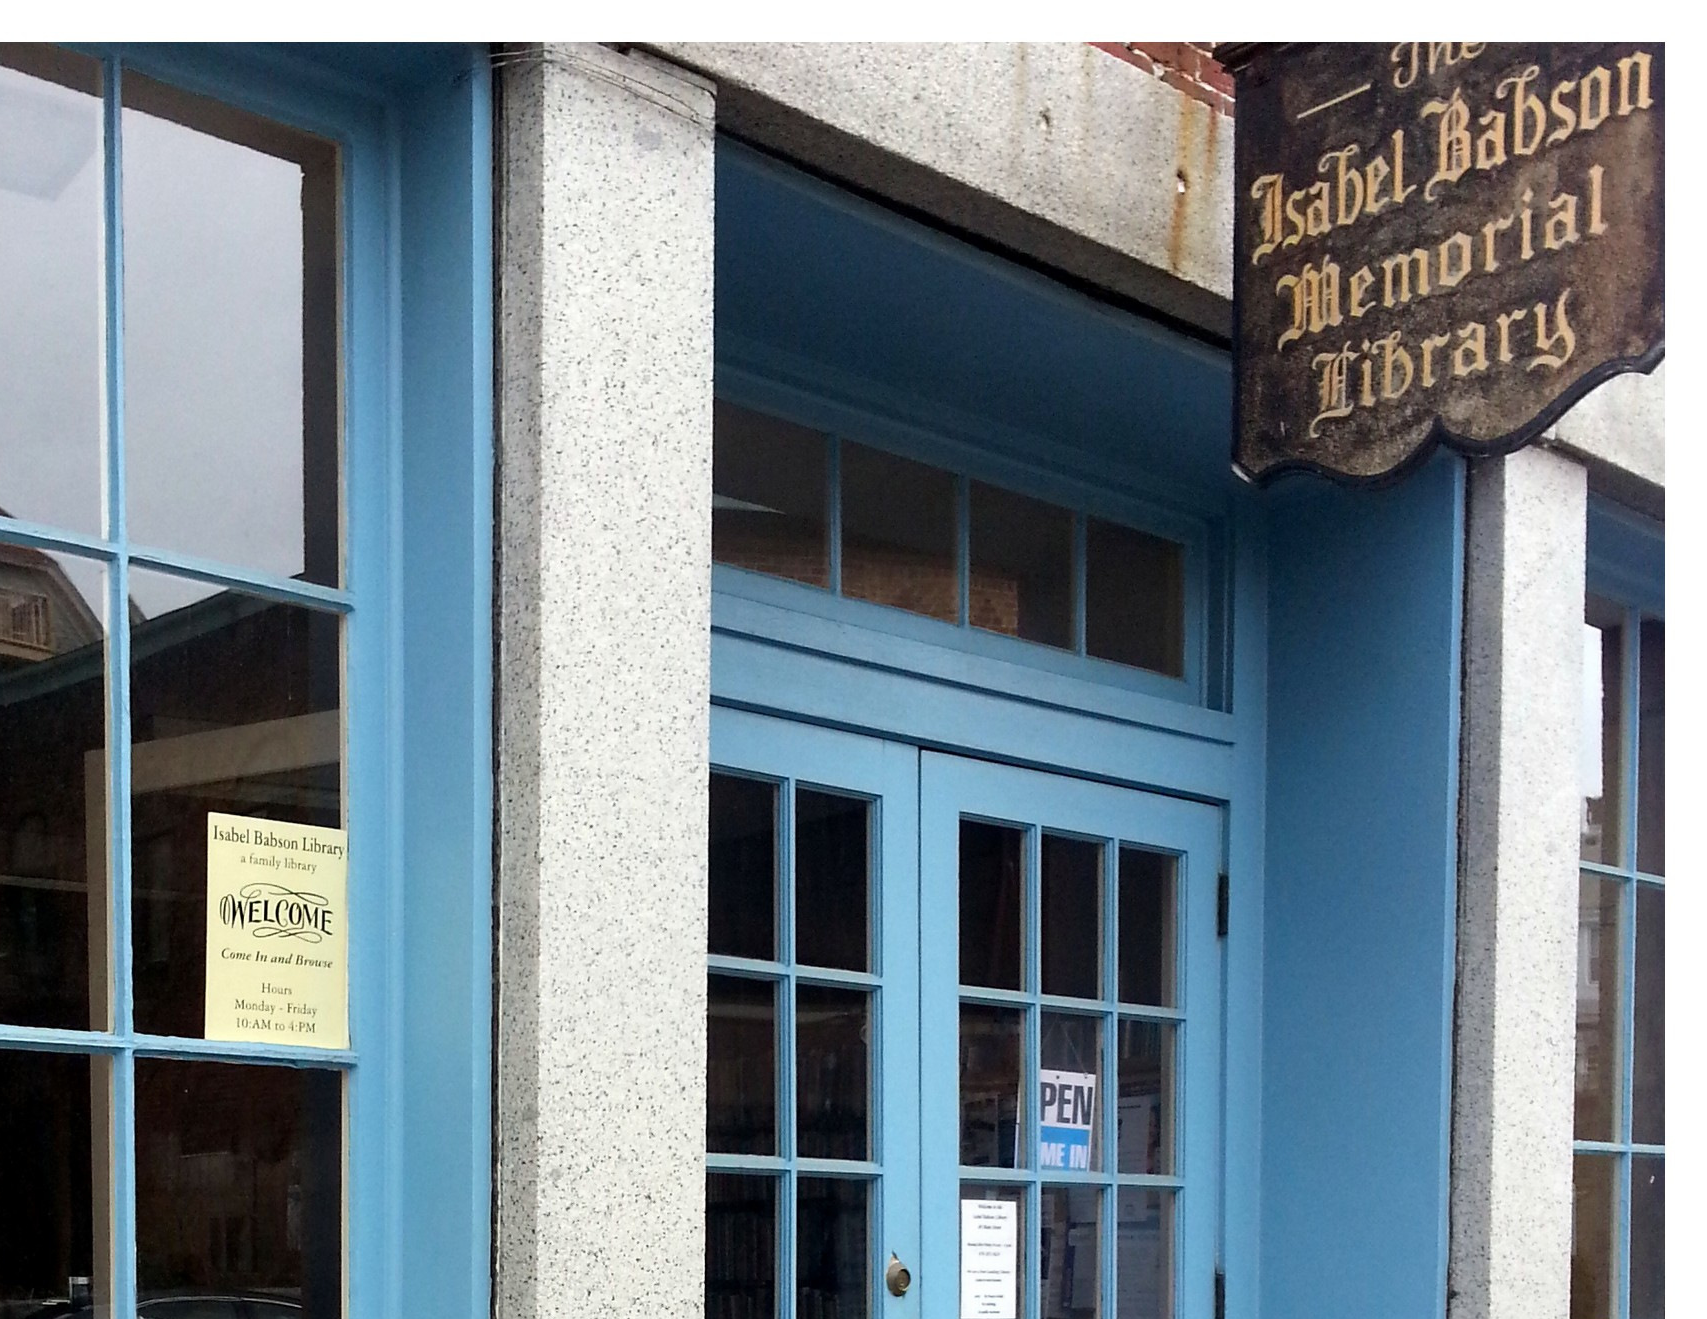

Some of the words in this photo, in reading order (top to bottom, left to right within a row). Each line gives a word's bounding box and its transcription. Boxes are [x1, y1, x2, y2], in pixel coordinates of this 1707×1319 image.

[1251, 129, 1417, 264] Isabel
[1420, 50, 1654, 201] Babson
[1276, 165, 1607, 352] Memorial
[1310, 288, 1576, 438] Library
[213, 825, 250, 845] Isabel
[254, 831, 298, 850] Babson
[302, 837, 344, 859] Library
[240, 856, 246, 864] a
[249, 853, 281, 870] family
[285, 858, 317, 874] library
[220, 889, 333, 937] WELCOME
[221, 948, 252, 962] Come
[255, 950, 268, 963] In
[270, 953, 293, 965] and
[295, 955, 333, 969] Browse
[261, 982, 292, 996] Hours
[235, 999, 276, 1015] Monday
[287, 1002, 317, 1018] Friday
[236, 1017, 271, 1031] 10:AM
[275, 1021, 285, 1032] to
[1040, 1081, 1093, 1125] PEN
[1041, 1141, 1066, 1167] ME
[1069, 1144, 1087, 1169] IN
